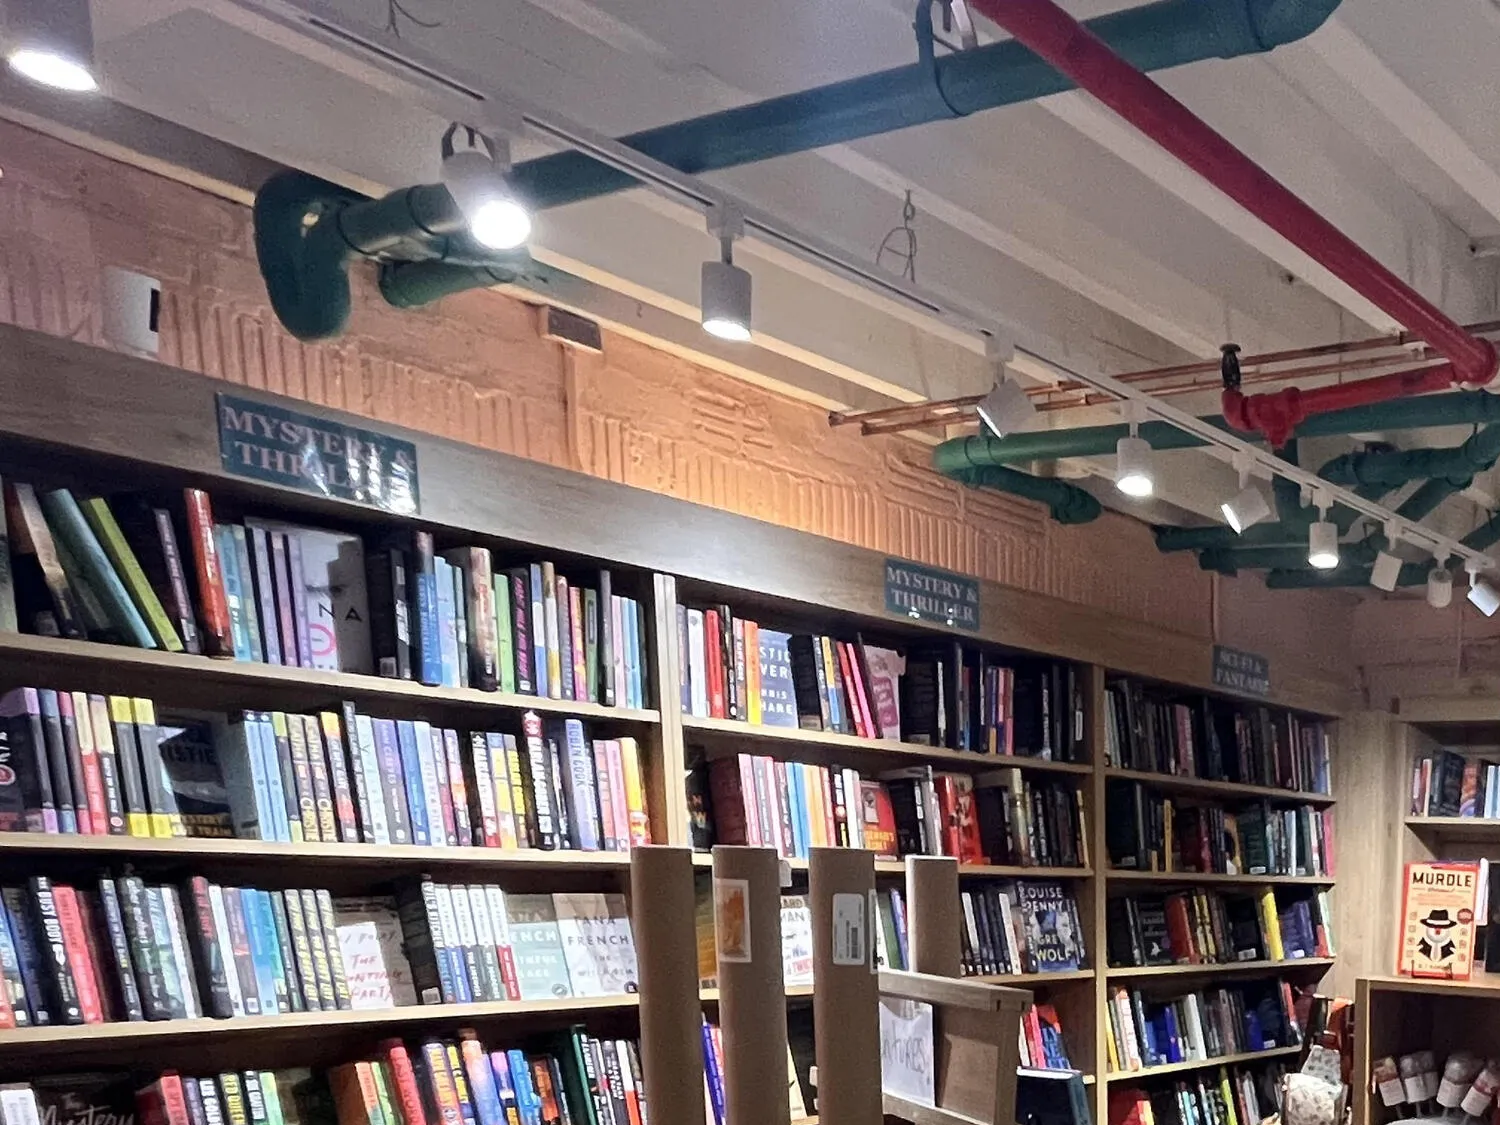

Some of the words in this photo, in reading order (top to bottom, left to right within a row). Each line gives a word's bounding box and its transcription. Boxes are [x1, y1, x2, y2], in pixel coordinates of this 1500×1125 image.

[221, 406, 388, 466] MYSTERY
[887, 566, 963, 599] MYSTERY
[966, 587, 977, 602] &
[891, 588, 974, 621] THRILLER
[759, 646, 790, 664] STIC
[760, 663, 788, 679] VER
[761, 688, 788, 700] NNIS
[567, 722, 583, 757] ROBIN
[571, 758, 587, 787] COOK
[1412, 872, 1472, 888] MURDLE
[37, 889, 55, 917] BUSY
[573, 915, 617, 926] TANA
[43, 916, 61, 945] BODY
[509, 930, 557, 943] ENCH
[567, 935, 630, 946] FRENCH
[1036, 946, 1072, 962] WOLF
